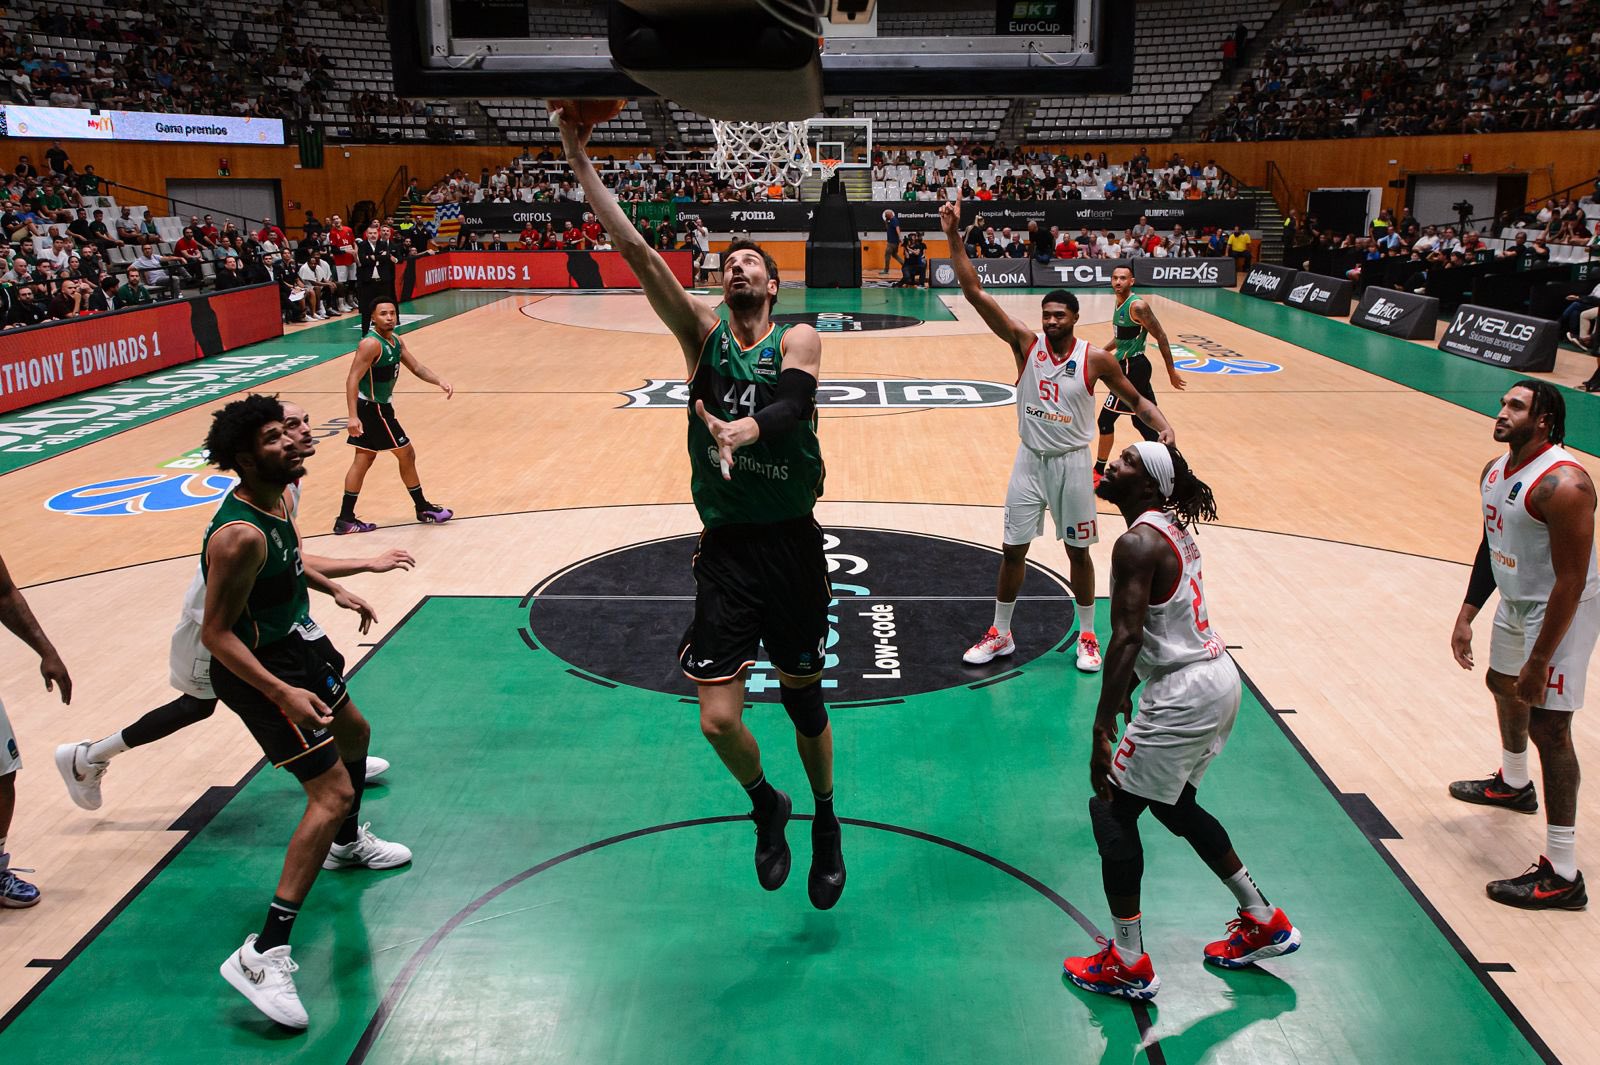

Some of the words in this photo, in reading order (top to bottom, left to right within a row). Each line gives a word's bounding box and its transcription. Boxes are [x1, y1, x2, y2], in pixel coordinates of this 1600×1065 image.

[1009, 21, 1060, 32] EuroCup
[156, 122, 183, 134] Gana
[186, 124, 227, 136] premios
[513, 212, 551, 222] GRIFOLS
[448, 265, 516, 280] EDWARDS
[522, 265, 530, 280] 1
[1054, 266, 1111, 282] TCL
[1152, 262, 1219, 280] DIREXIS
[1579, 265, 1587, 273] 12
[1474, 315, 1536, 341] MERLOS
[71, 334, 148, 377] EDWARDS
[152, 331, 161, 356] 1
[723, 384, 757, 417] 44
[1039, 379, 1059, 403] 51
[3, 422, 121, 453] Palau
[97, 383, 238, 421] Municipal
[1077, 519, 1097, 540] 51
[1486, 503, 1503, 537] 24
[858, 603, 901, 679] Low-code
[1113, 736, 1135, 771] 2
